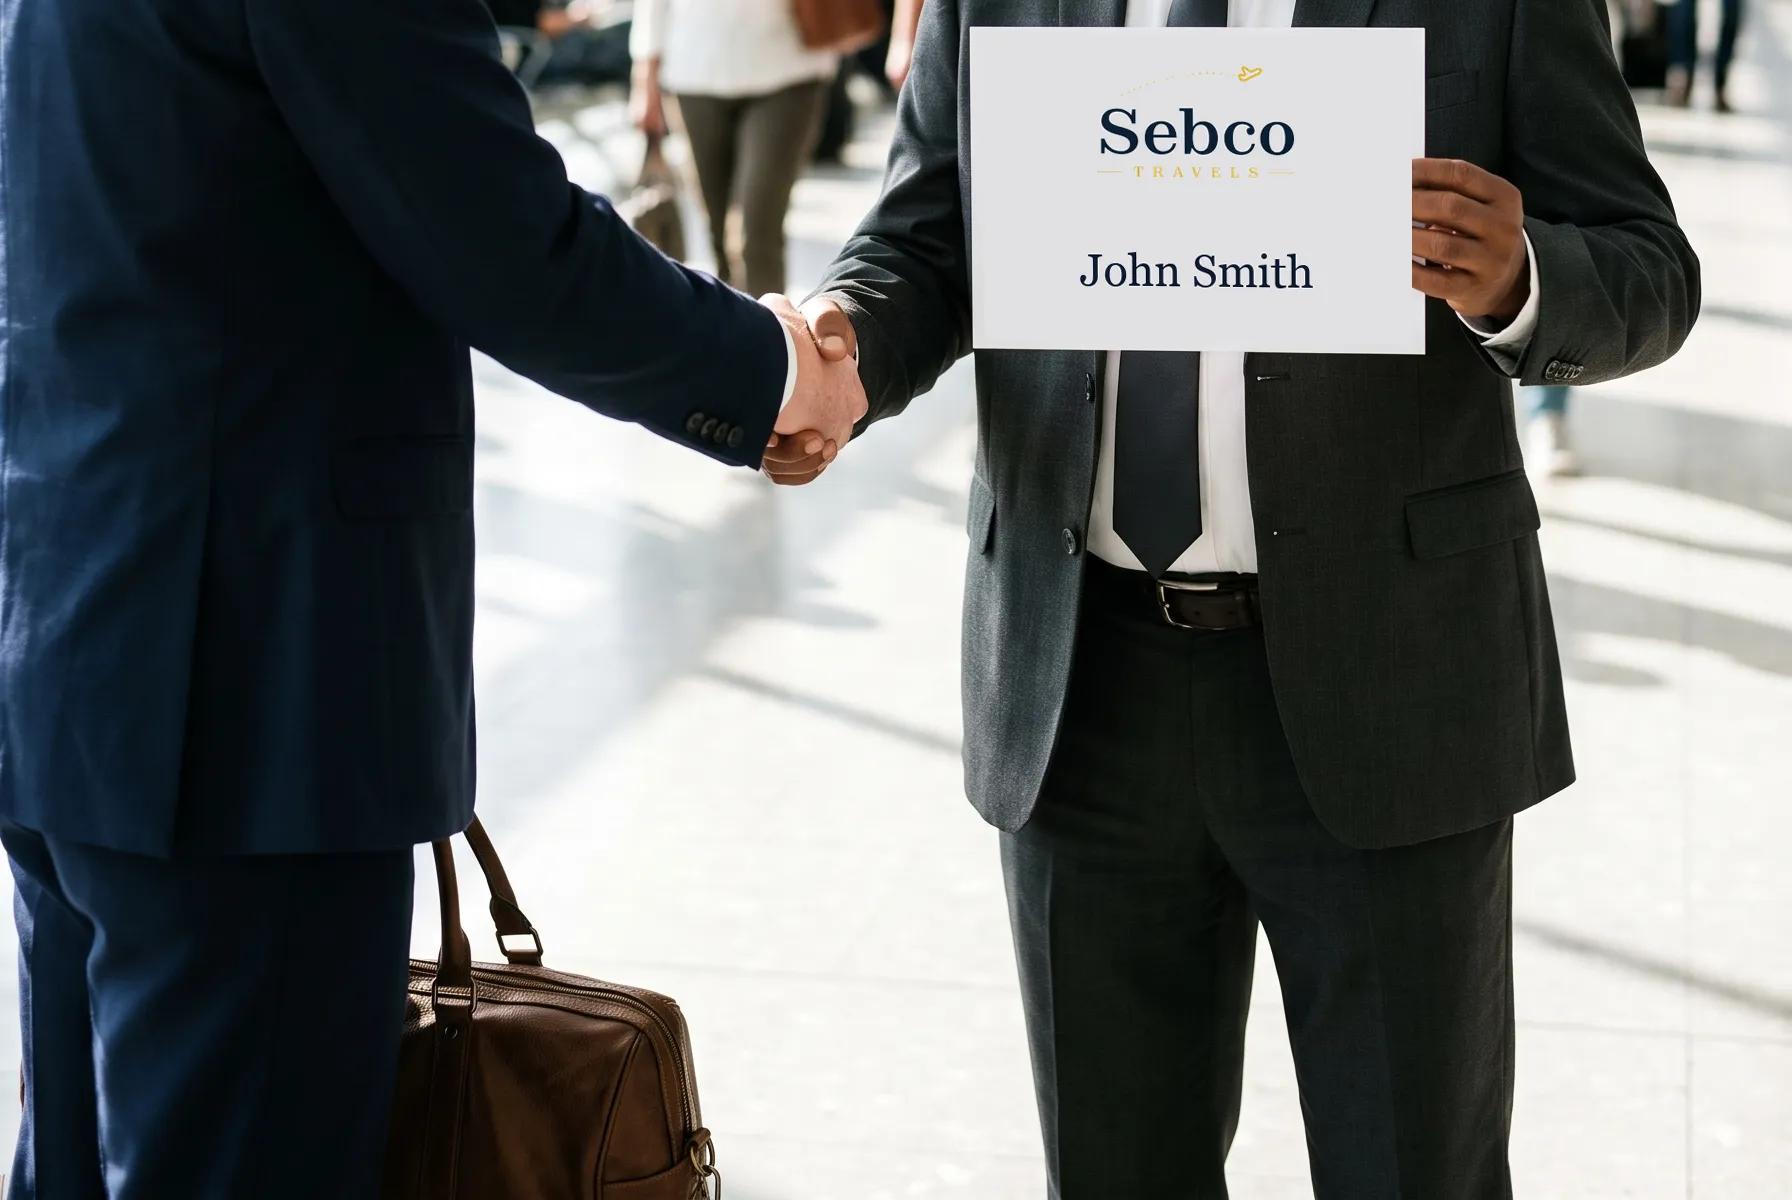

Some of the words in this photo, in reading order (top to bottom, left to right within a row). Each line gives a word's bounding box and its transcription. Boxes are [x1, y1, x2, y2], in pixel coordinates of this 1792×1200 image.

[1100, 107, 1295, 156] Sebco
[1133, 165, 1260, 179] TRAVELS
[1079, 251, 1181, 288] John
[1193, 252, 1314, 290] Smith
